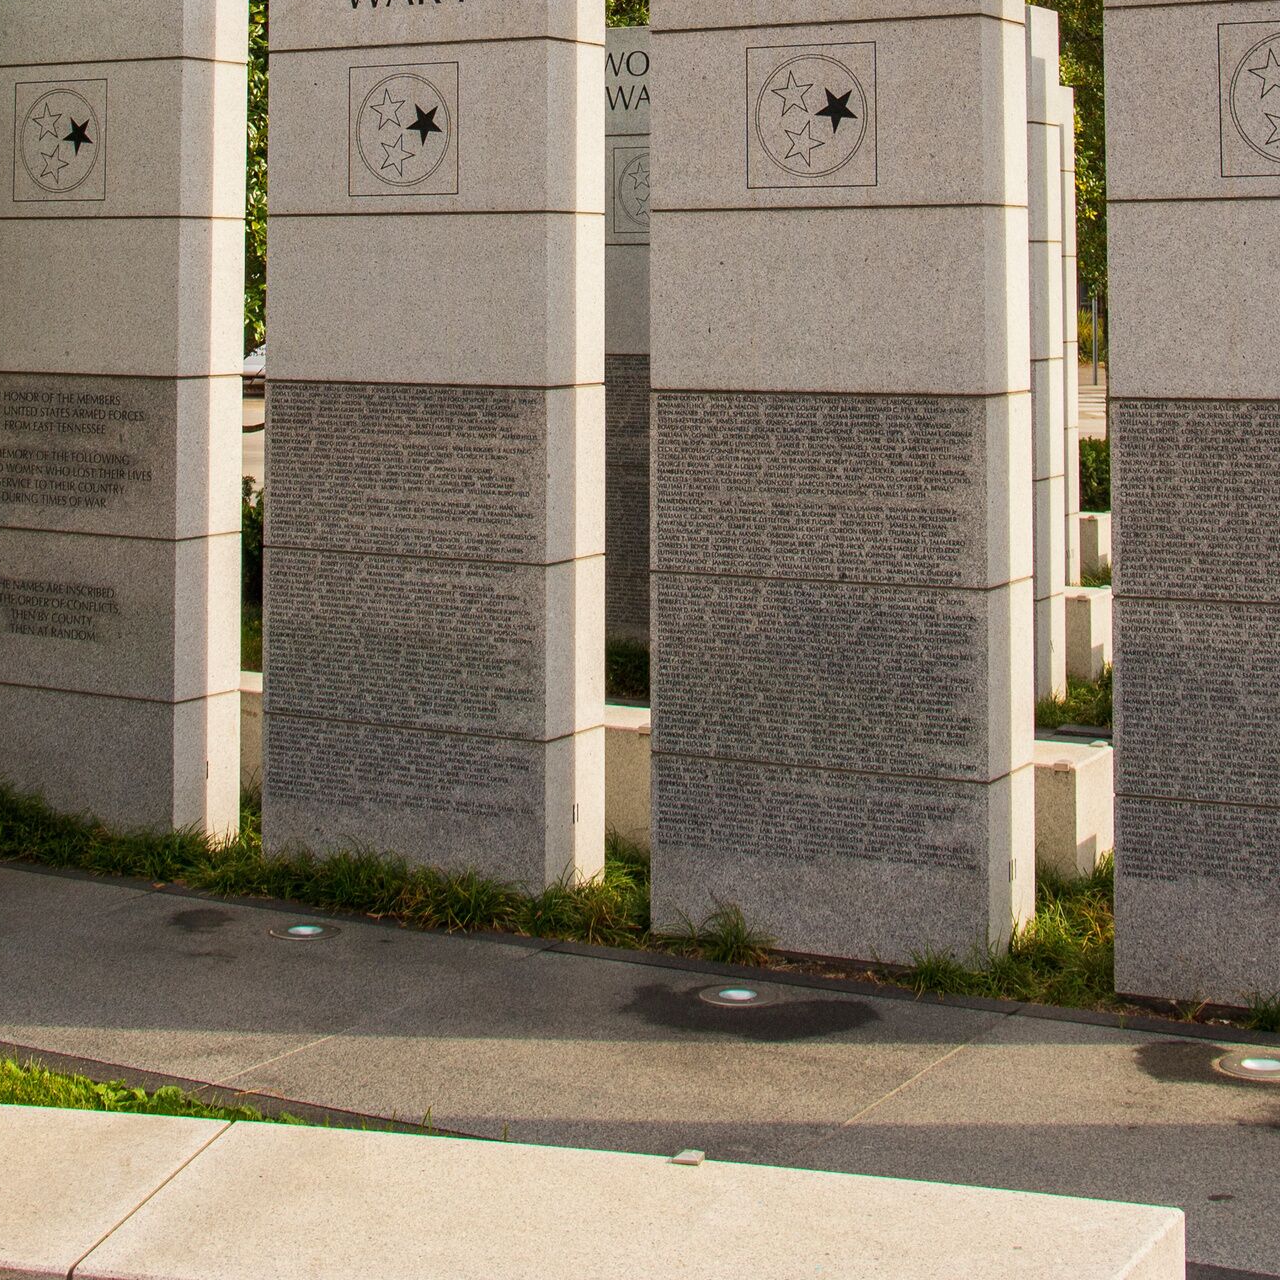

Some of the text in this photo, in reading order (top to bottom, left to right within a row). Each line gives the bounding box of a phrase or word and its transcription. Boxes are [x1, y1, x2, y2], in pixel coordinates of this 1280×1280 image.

[4, 392, 39, 402] HONOR
[42, 393, 54, 403] OF
[57, 393, 73, 403] THE
[77, 394, 121, 405] MEMBERS
[3, 406, 37, 416] UNITED
[40, 408, 71, 418] STATES
[72, 409, 106, 419] ARMED
[108, 411, 144, 421] FORCES
[4, 421, 106, 434] FROM EAST TENNESSEE
[36, 451, 49, 460] OF
[52, 452, 69, 462] THE
[72, 453, 129, 465] FOLLOWING
[6, 464, 43, 474] WOMEN
[45, 466, 71, 476] WHO
[73, 468, 96, 477] LOST
[98, 469, 126, 480] THEIR
[129, 471, 152, 481] LIVES
[34, 480, 47, 489] TO
[49, 481, 74, 491] THEIR
[78, 482, 124, 494] COUNTRY
[2, 492, 106, 508] DURING TIMES OF WAR
[13, 580, 45, 593] NAMES
[47, 582, 64, 594] ARE
[66, 584, 115, 599] INSCRIBED
[0, 593, 16, 603] THE
[18, 595, 50, 607] ORDER
[52, 597, 65, 608] OF
[11, 608, 35, 619] THEN
[38, 610, 50, 620] BY
[10, 623, 35, 634] THEN
[37, 625, 49, 636] AT
